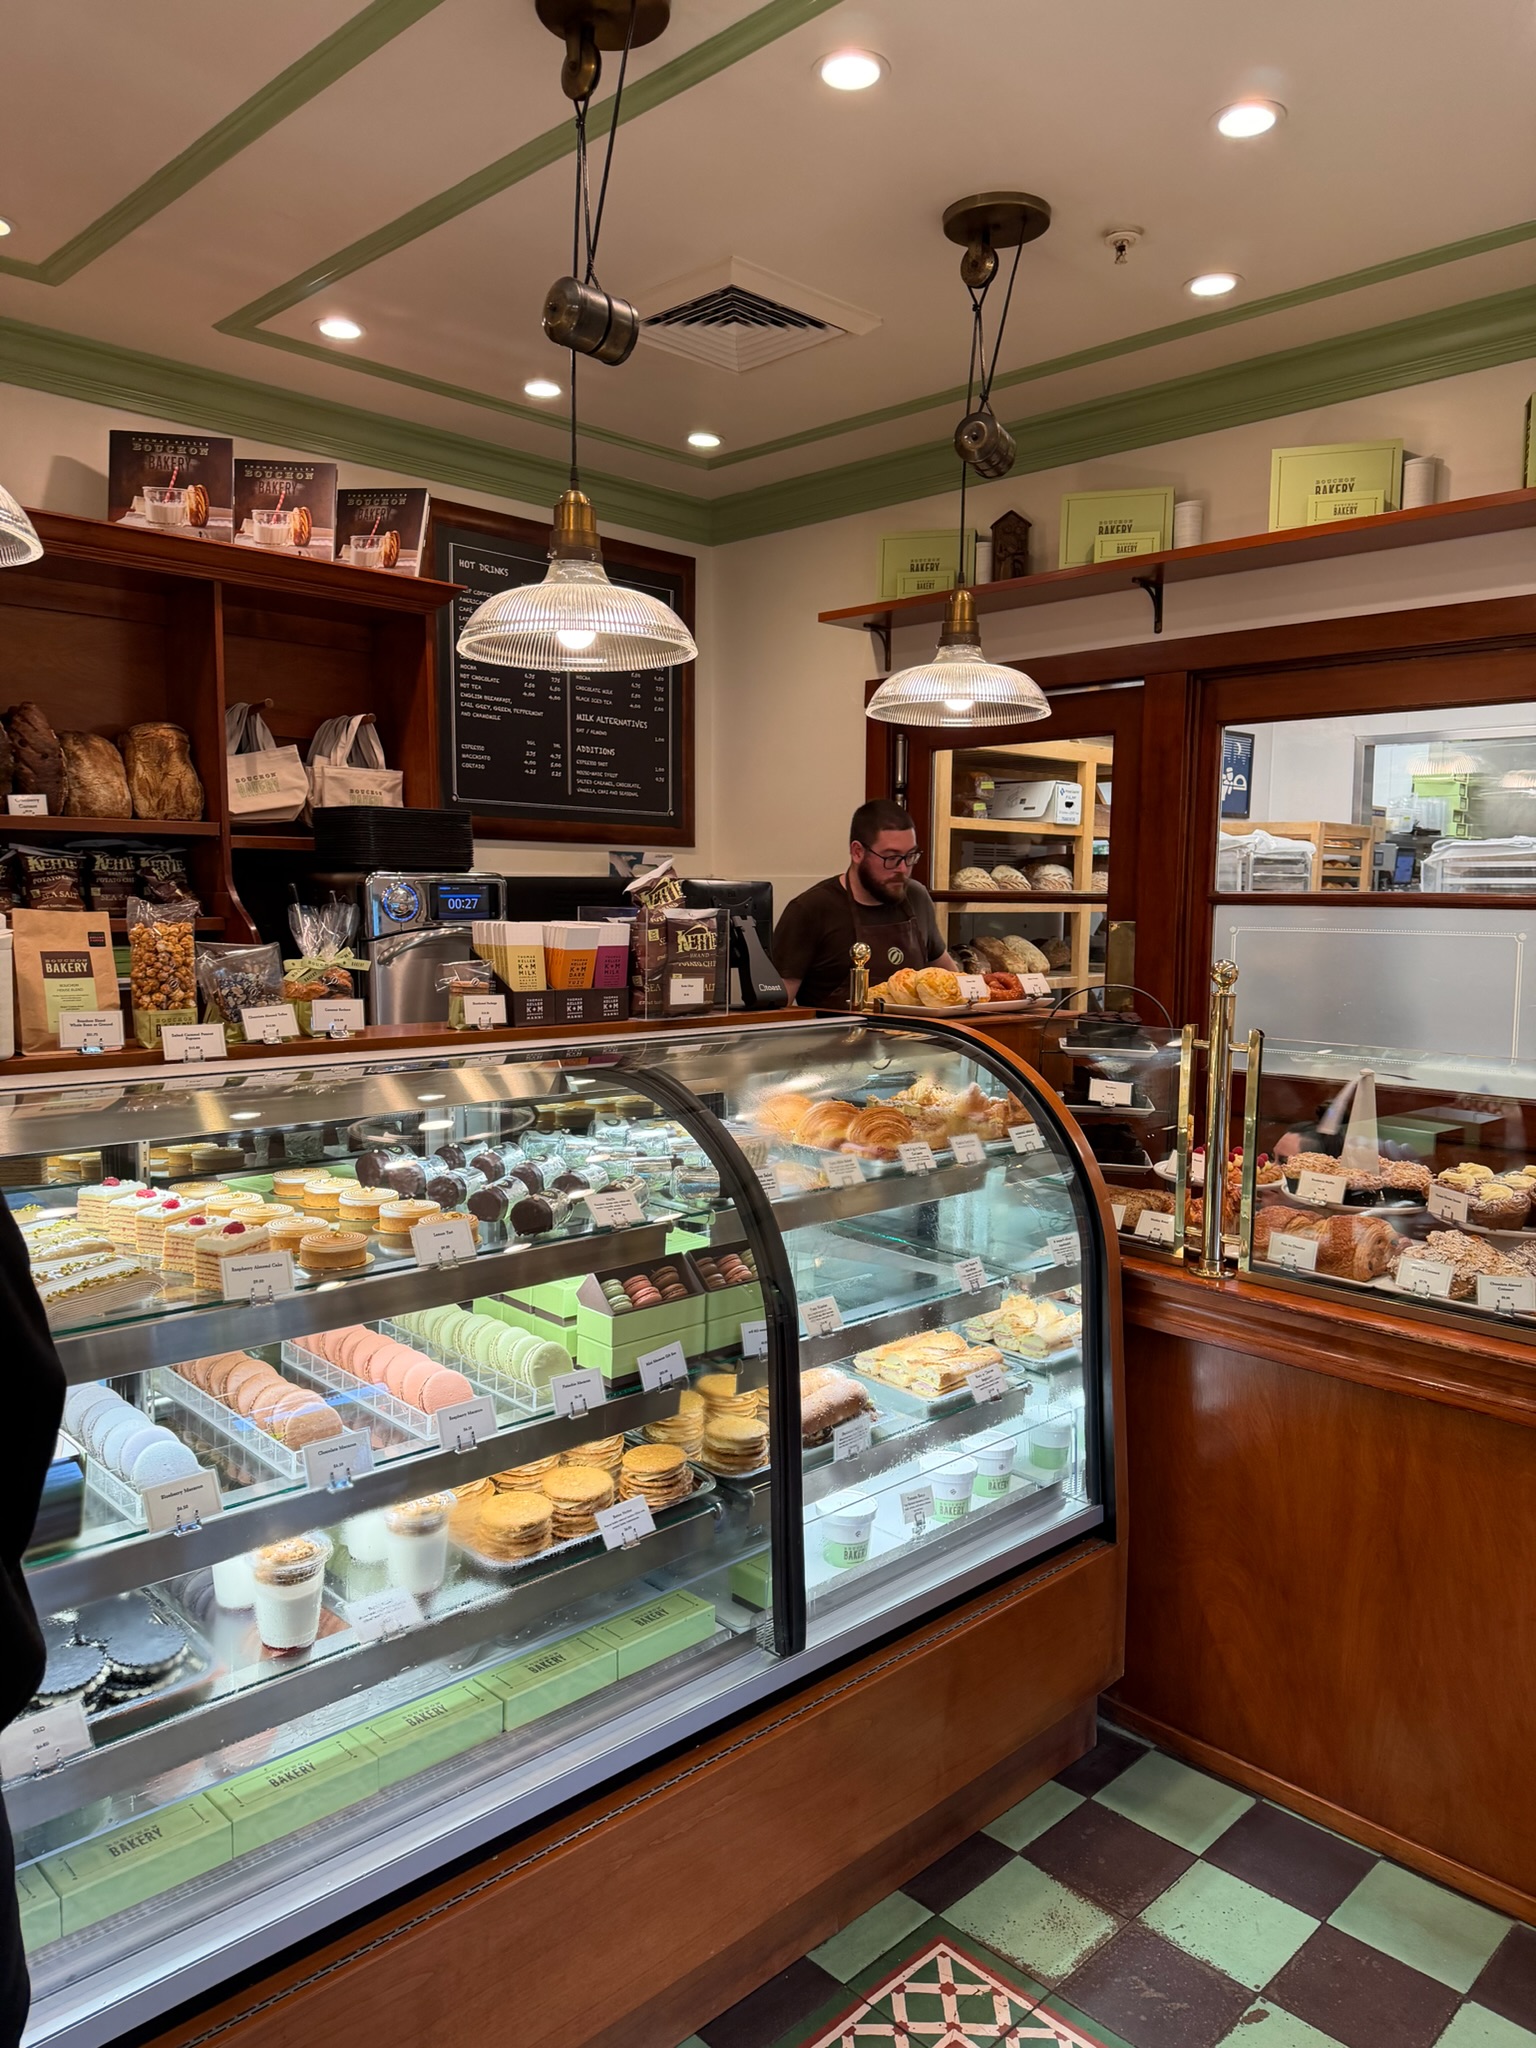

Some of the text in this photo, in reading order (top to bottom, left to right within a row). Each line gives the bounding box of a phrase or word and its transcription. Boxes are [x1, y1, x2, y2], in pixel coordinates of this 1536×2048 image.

[132, 443, 209, 456] BOUCHON
[149, 455, 191, 472] BAKERY
[245, 470, 314, 480] BOUCHON
[1315, 477, 1356, 485] BOUCHON
[259, 481, 297, 495] BAKERY
[1315, 483, 1355, 495] BAKERY
[1334, 506, 1358, 516] BAKERY
[1099, 524, 1133, 535] BAKERY
[1117, 545, 1138, 554] BAKERY
[459, 559, 509, 577] HOT DRINKS
[910, 563, 940, 572] BAKERY
[471, 675, 500, 684] CHOCOLATE
[576, 714, 648, 729] MILK ALTERNATIVES
[576, 745, 616, 756] ADDITIONS
[235, 772, 277, 784] BOUCHON
[60, 891, 79, 900] SALT
[448, 898, 479, 910] 00:27
[46, 963, 88, 973] BAKERY
[940, 1506, 965, 1516] BAKERY
[634, 1608, 670, 1627] BAKERY
[528, 1654, 567, 1674] BAKERY
[405, 1704, 449, 1727] BAKERY
[269, 1762, 316, 1788] BAKERY
[109, 1828, 163, 1857] BAKERY
